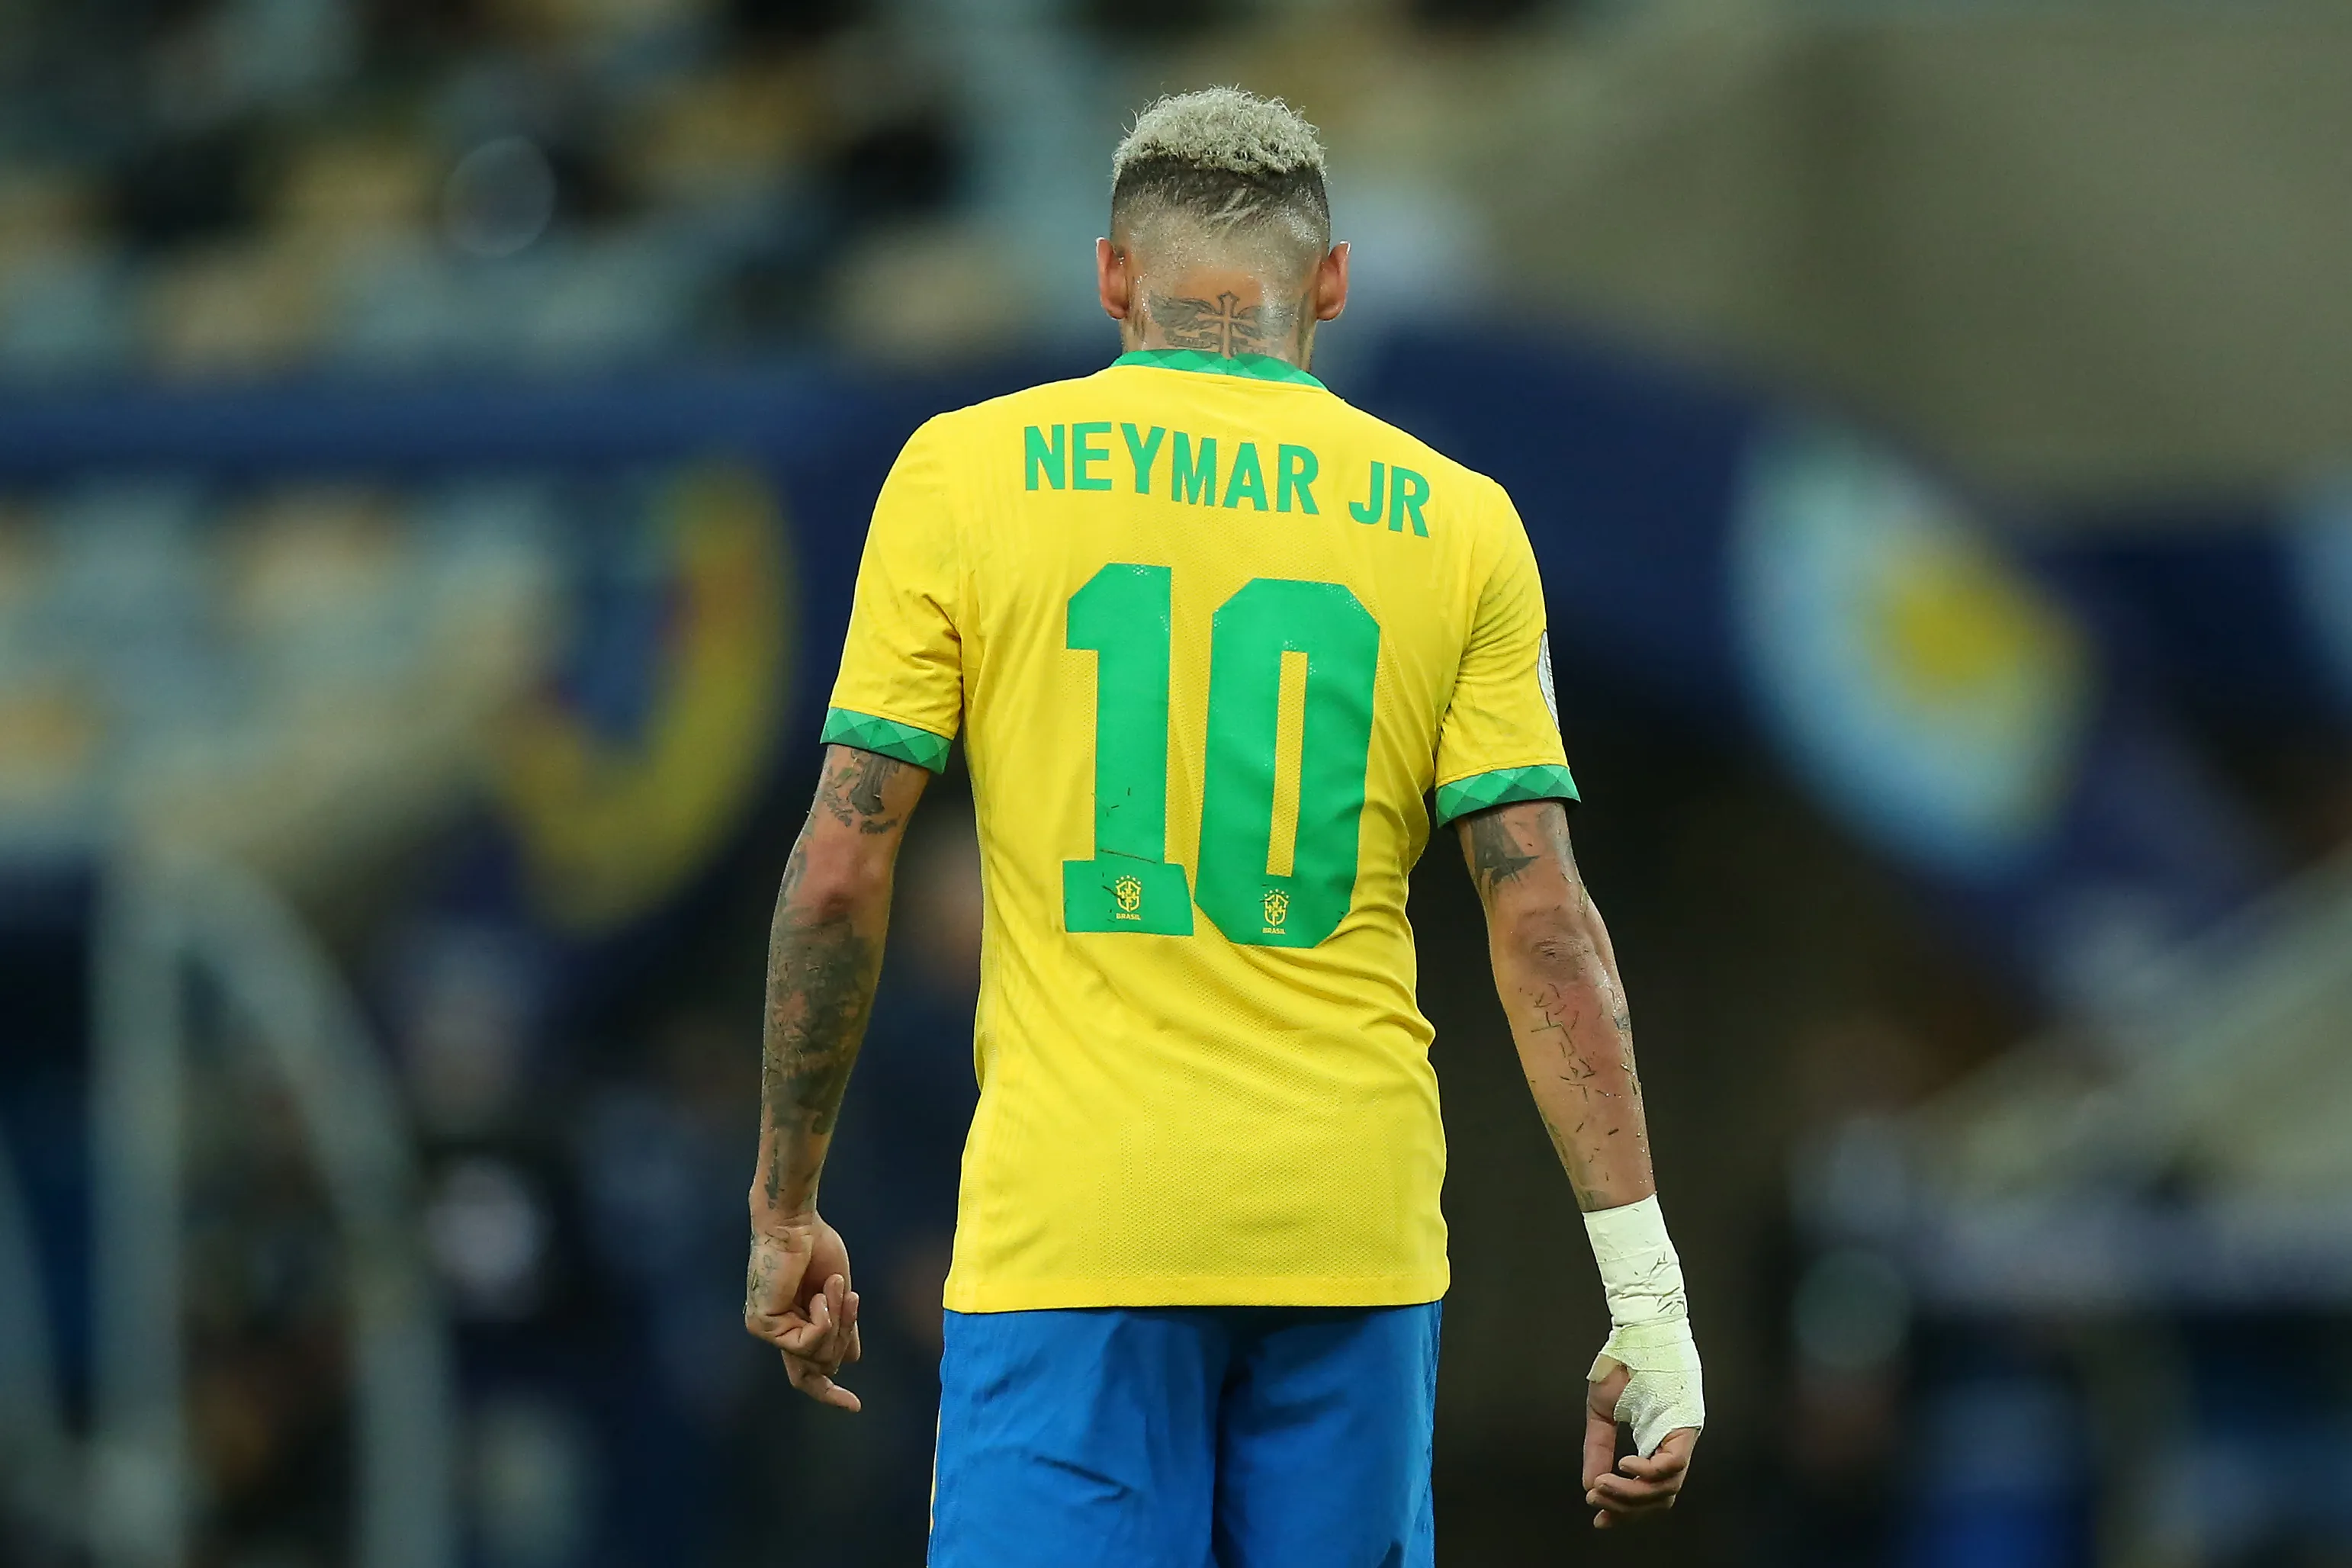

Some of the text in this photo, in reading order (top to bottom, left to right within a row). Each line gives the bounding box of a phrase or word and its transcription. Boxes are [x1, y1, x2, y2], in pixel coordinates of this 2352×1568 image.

[1024, 421, 1430, 538] NEYMAR JR
[1062, 562, 1380, 949] 10
[1116, 912, 1142, 921] BRASIL
[1262, 927, 1286, 935] BRASIL
